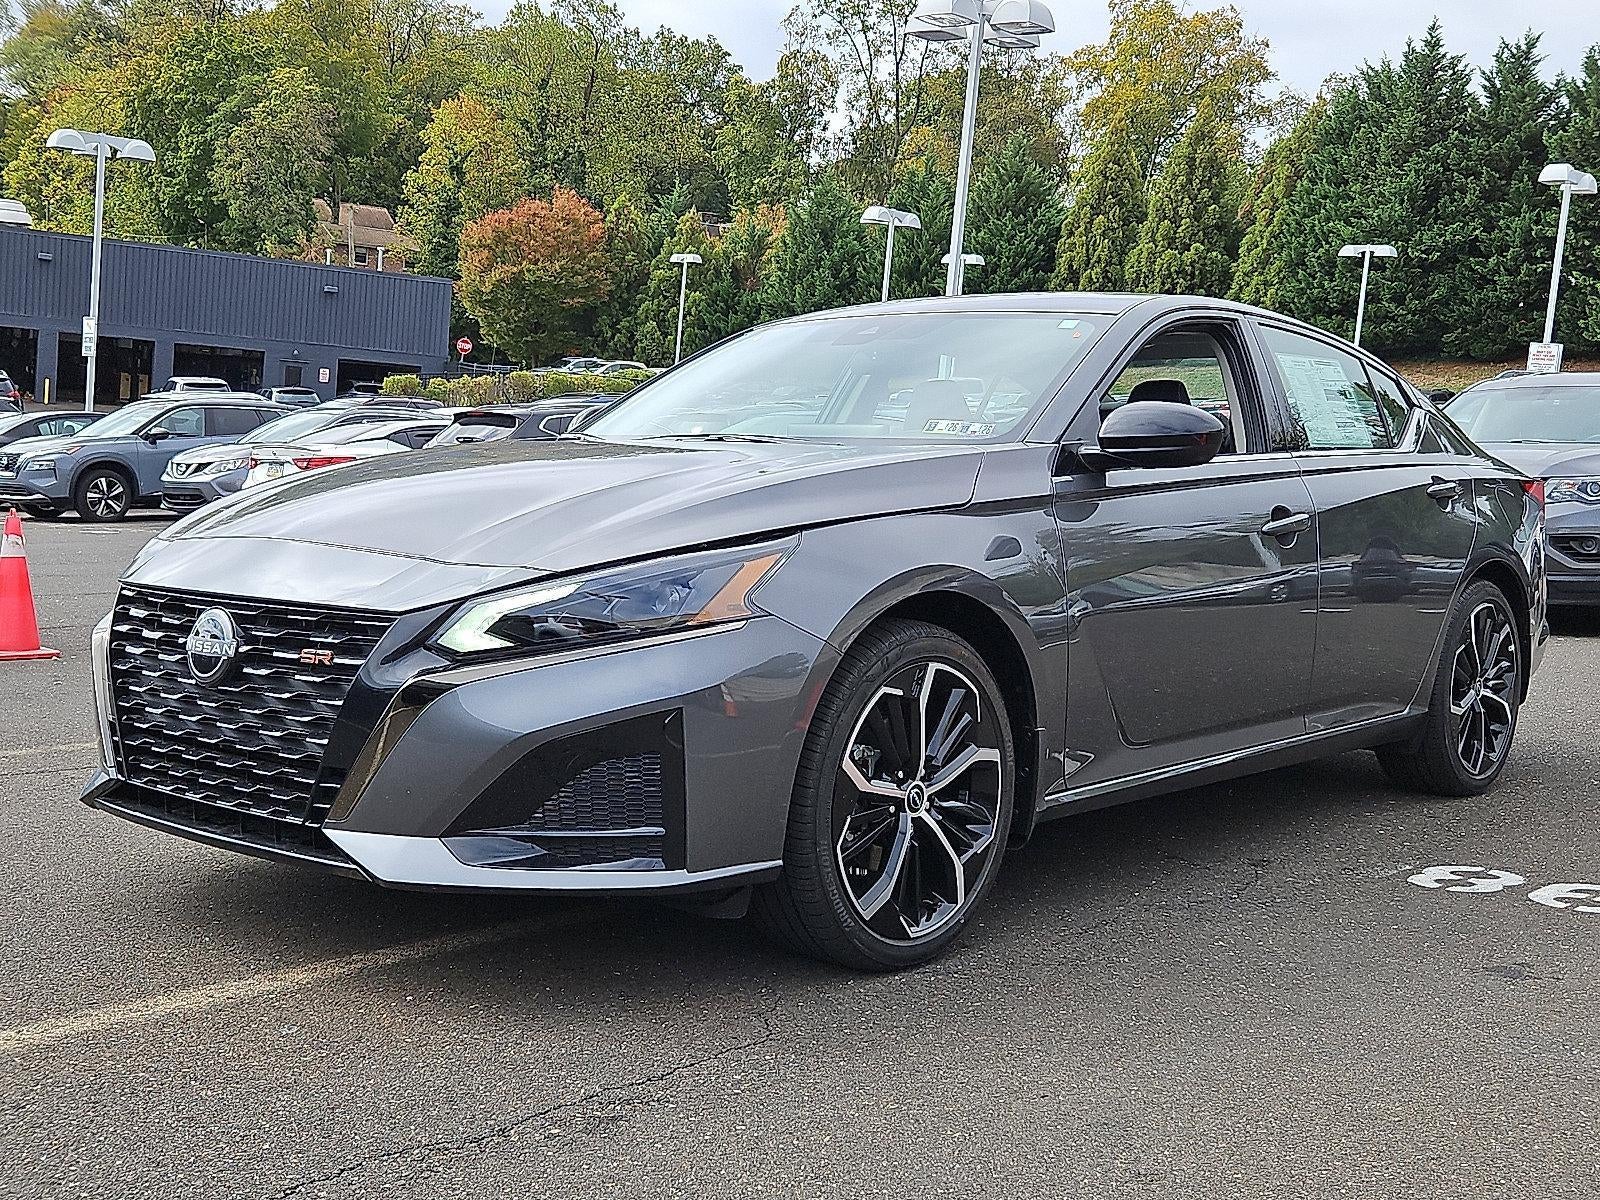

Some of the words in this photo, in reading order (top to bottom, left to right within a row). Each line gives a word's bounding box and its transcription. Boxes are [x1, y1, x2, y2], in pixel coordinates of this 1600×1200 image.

[458, 342, 471, 350] STOP
[187, 636, 236, 656] NISSAN
[300, 648, 334, 665] SR
